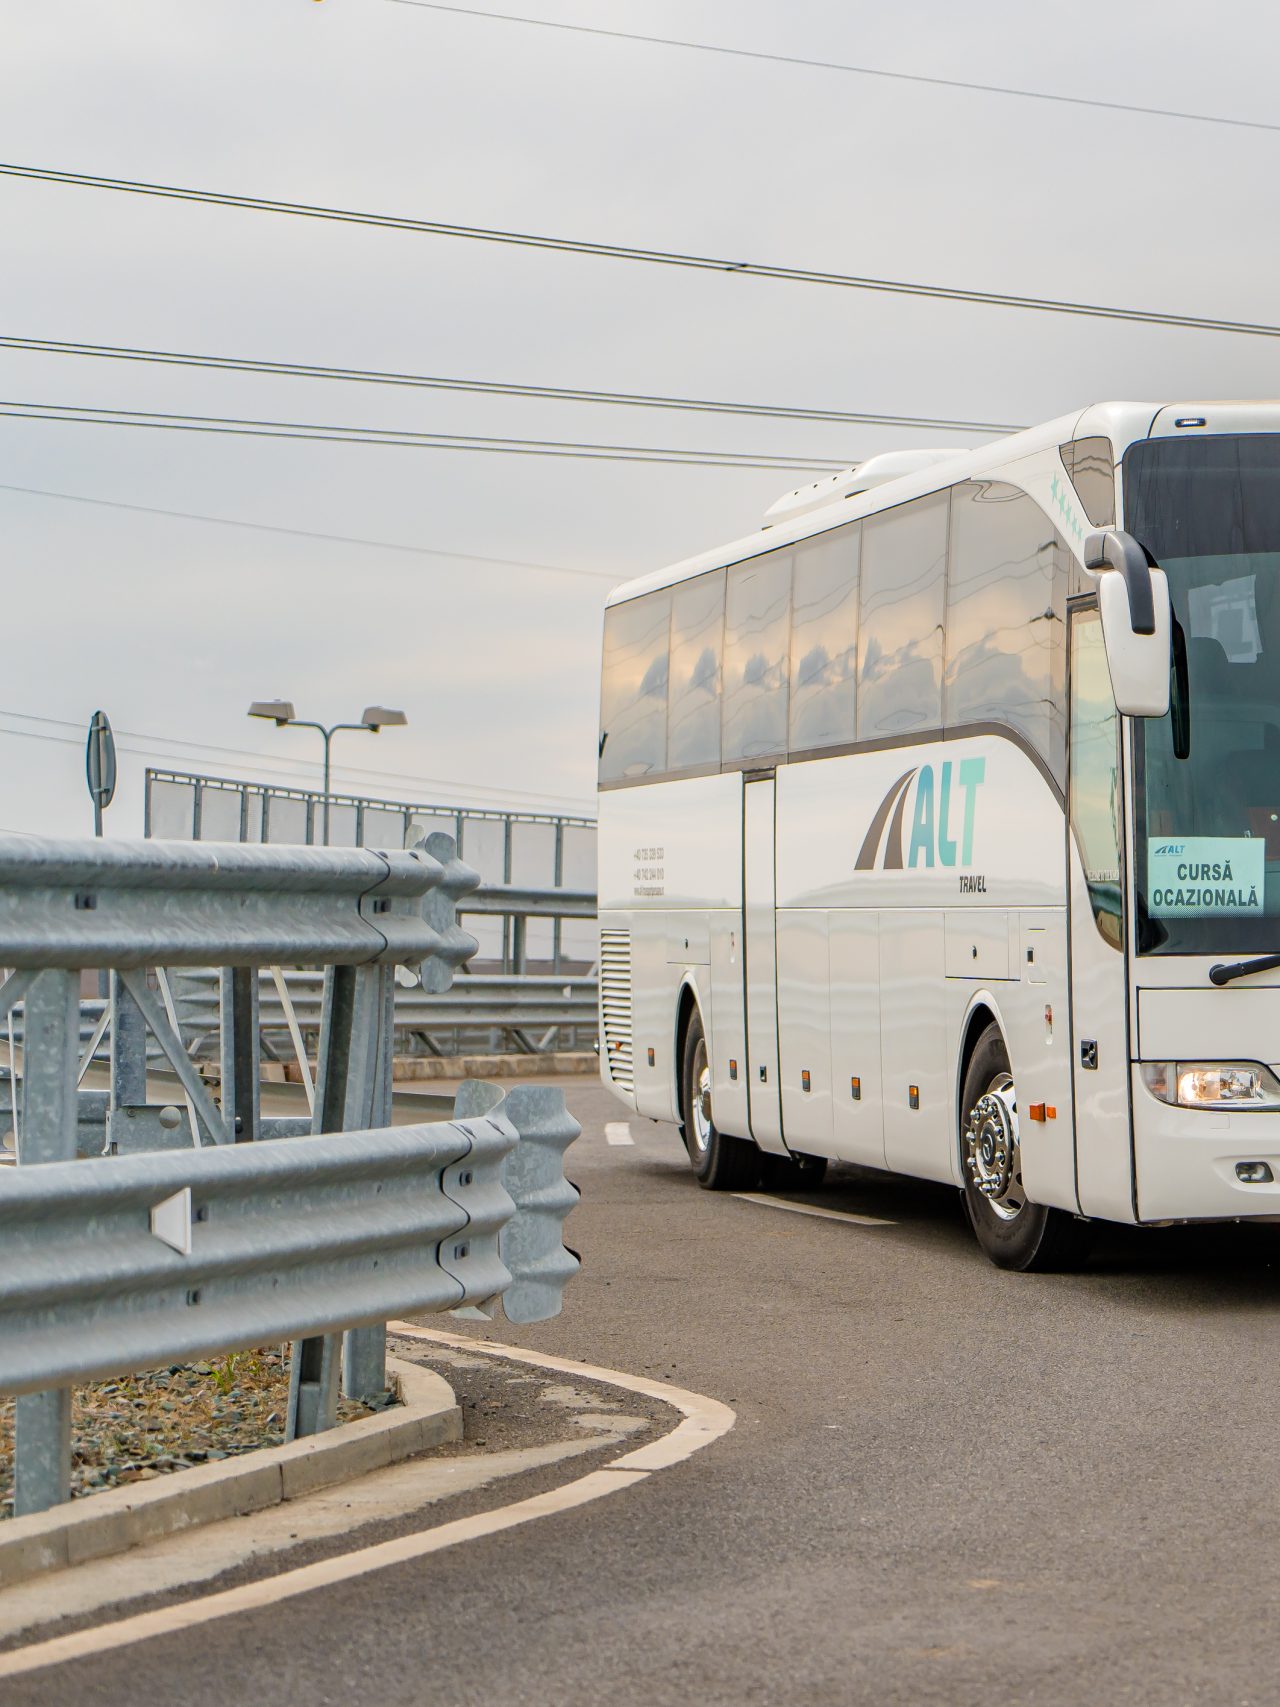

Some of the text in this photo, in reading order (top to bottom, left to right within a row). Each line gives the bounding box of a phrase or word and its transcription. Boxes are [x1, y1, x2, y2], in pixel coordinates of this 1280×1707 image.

[908, 758, 985, 868] ALT
[1168, 845, 1185, 854] ALT
[1177, 859, 1233, 881] CURSĂ
[959, 875, 987, 893] TRAVEL
[1153, 885, 1259, 906] OCAZIONALĂ
